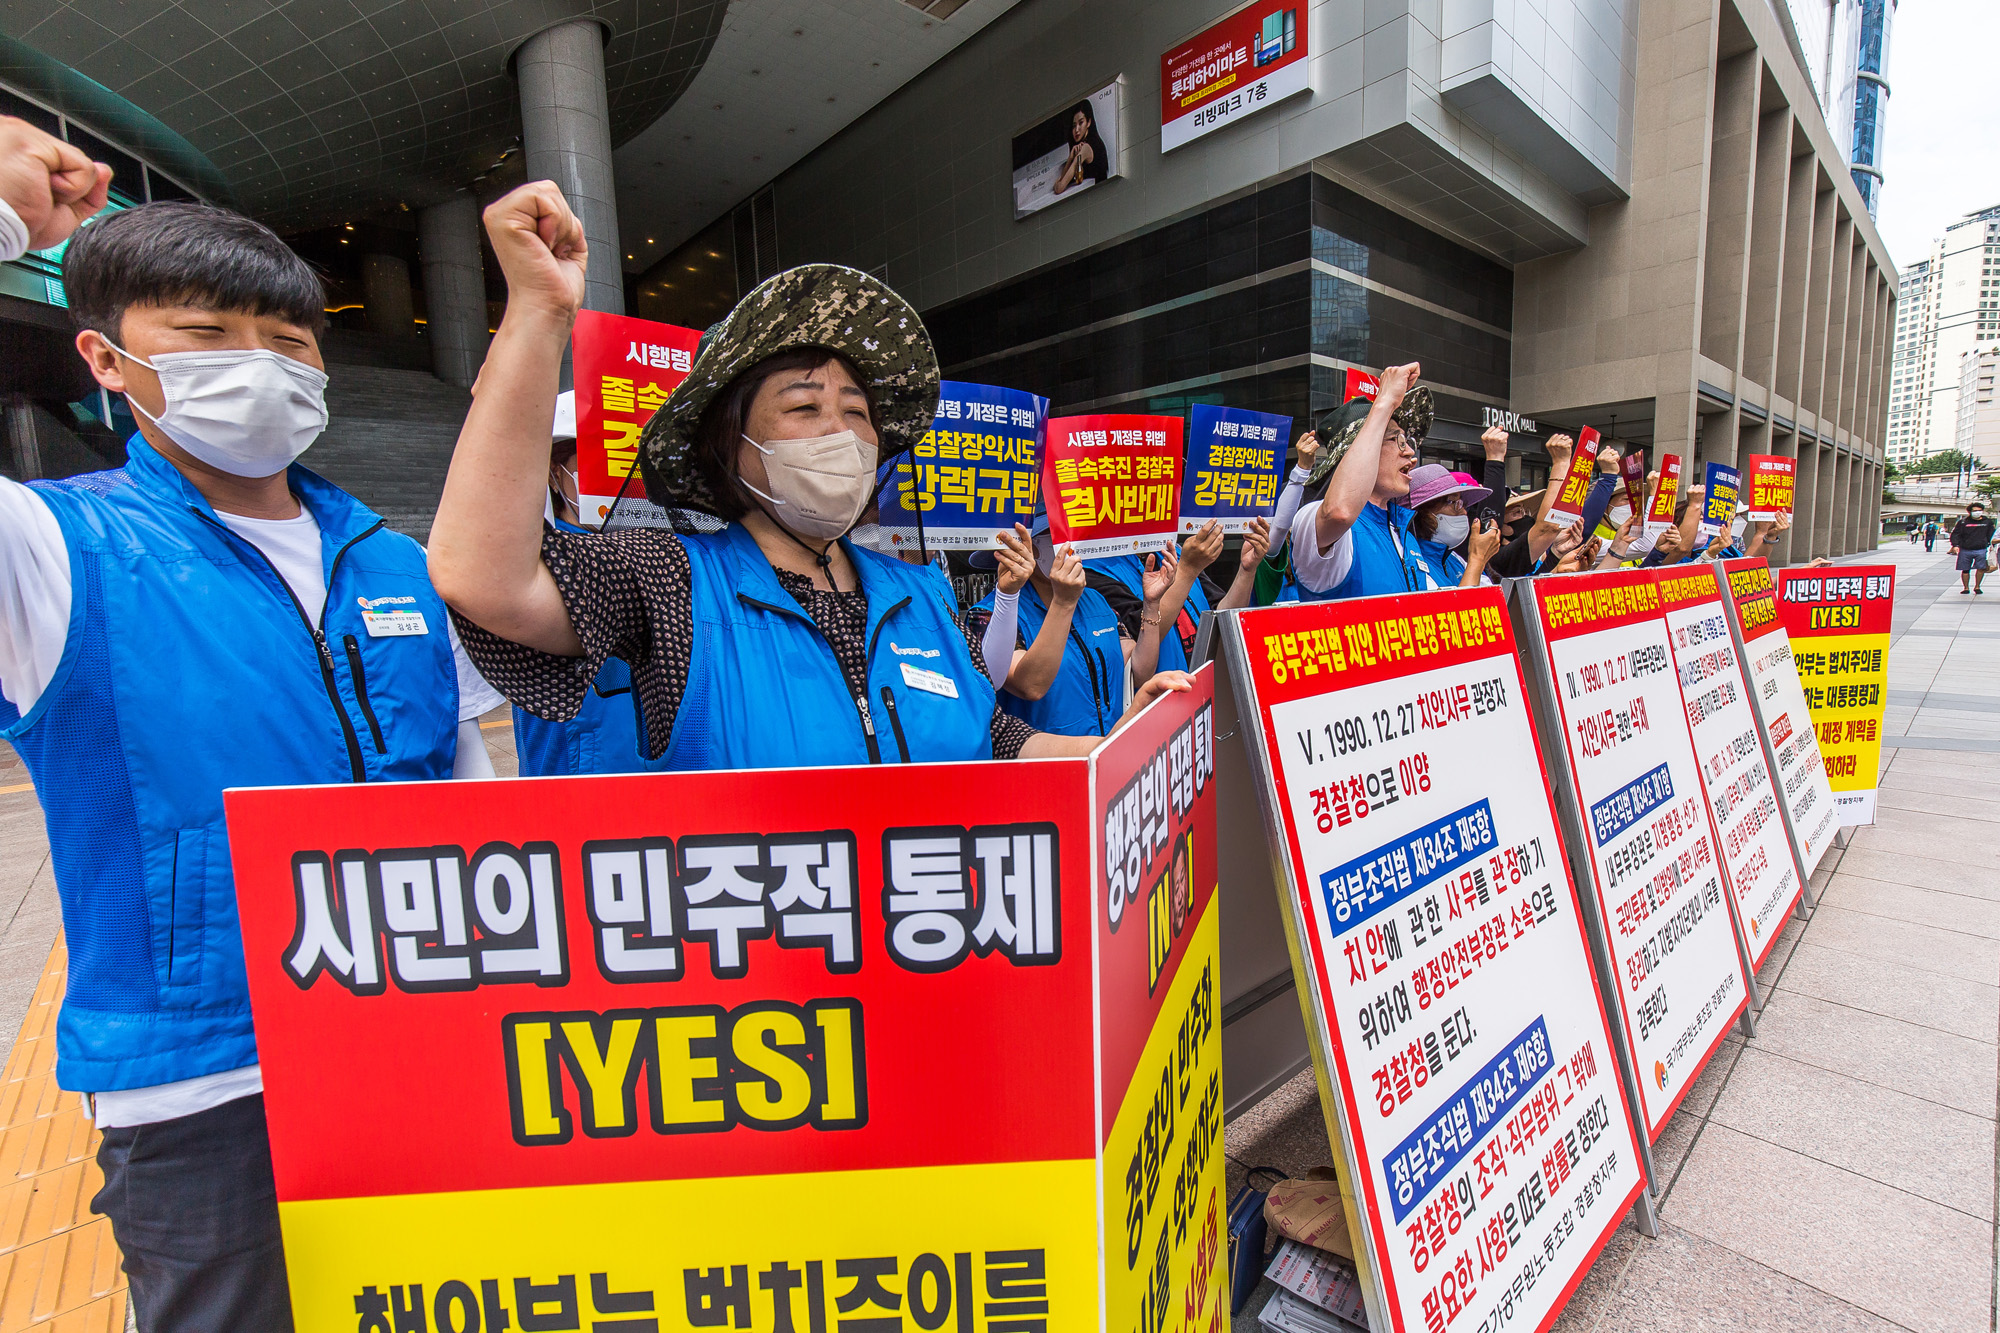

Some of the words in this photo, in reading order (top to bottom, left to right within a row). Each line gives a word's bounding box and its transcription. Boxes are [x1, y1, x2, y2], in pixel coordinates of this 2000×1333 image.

[1170, 46, 1248, 100] 롯데하이마트
[1194, 94, 1242, 127] 리빙파크
[1247, 82, 1268, 103] 7층
[626, 341, 691, 373] 시행령
[601, 375, 677, 414] 졸속
[966, 402, 1008, 424] 개정은
[1011, 408, 1035, 429] 위법!
[914, 429, 1036, 466] 경찰장악시도
[1067, 430, 1107, 448] 시행령
[1110, 431, 1143, 446] 개정은
[1145, 431, 1166, 447] 위법!
[1212, 421, 1239, 438] 시행령
[1240, 423, 1261, 440] 개정은
[1261, 427, 1278, 442] 위법!
[1520, 417, 1537, 433] MALL
[1054, 456, 1132, 484] 졸속추진
[1135, 456, 1175, 480] 경찰국
[1209, 445, 1275, 469] 경찰장악시도
[1060, 484, 1173, 528] 결사반대!
[1194, 471, 1278, 508] 강력규탄!
[905, 536, 961, 544] 국가무원노동조합
[1544, 591, 1583, 629] 정부조직법
[1579, 591, 1597, 621] 치안
[1594, 588, 1615, 619] 사무의
[1613, 586, 1626, 616] 관장
[1624, 584, 1638, 614] 주체
[1636, 583, 1649, 612] 변경
[1647, 582, 1660, 609] 연혁
[1784, 578, 1822, 602] 시민의
[1825, 576, 1863, 601] 민주적
[1866, 575, 1891, 599] 통제
[1263, 627, 1347, 684] 정부조직법
[1343, 623, 1376, 668] 치안
[1375, 617, 1416, 662] 사무의
[1414, 615, 1439, 656] 관장
[1438, 611, 1463, 651] 주체
[1460, 608, 1483, 647] 변경
[1481, 605, 1505, 642] 연혁
[1810, 605, 1860, 629] [YES]
[1580, 663, 1604, 694] 1990.
[1604, 659, 1617, 686] 12.
[1617, 655, 1628, 681] 27
[1628, 644, 1668, 678] 내무부장관의
[1795, 653, 1825, 676] 안부는
[1829, 649, 1882, 674] 법치주의를
[1297, 729, 1324, 767] V.
[1324, 716, 1372, 758] 1990.
[1372, 709, 1398, 744] 12.
[1398, 702, 1415, 737] 27
[1416, 684, 1471, 731] 치안사무
[1471, 677, 1508, 716] 관장자
[1804, 687, 1823, 710] 하는
[1827, 684, 1880, 709] 대통령령과
[1577, 709, 1617, 759] 치안사무
[1616, 710, 1632, 742] 권한
[1629, 696, 1649, 735] 삭제
[1821, 722, 1842, 745] 제정
[1845, 719, 1877, 744] 계획을
[1309, 766, 1400, 835] 경찰청으로
[1399, 751, 1432, 796] 이양
[1823, 755, 1857, 778] 회하라
[1105, 742, 1169, 932] 행정부의
[1169, 718, 1194, 822] 직접
[1194, 699, 1213, 797] 통제
[1594, 790, 1634, 840] 정부조직법
[1629, 775, 1655, 815] 제34조
[1651, 766, 1672, 802] 제1항
[1328, 846, 1412, 923] 정부조직법
[1410, 822, 1459, 878] 제34조
[1455, 806, 1493, 852] 제5항
[1605, 829, 1655, 888] 내무부장관은
[1616, 887, 1650, 938] 국민투표
[1646, 881, 1657, 914] 및
[1653, 860, 1682, 907] 민방위에
[1678, 849, 1694, 885] 관한
[1691, 835, 1711, 871] 사무를
[284, 841, 569, 994] 시민의
[582, 829, 862, 984] 민주적
[882, 823, 1060, 973] 통제
[1343, 918, 1403, 987] 치안에
[1407, 894, 1443, 948] 관한
[1445, 867, 1490, 922] 사무를
[1489, 836, 1546, 895] 관장하기
[1626, 936, 1660, 992] 장리하고
[1658, 892, 1704, 957] 지방자치단체의
[1700, 876, 1720, 913] 사무를
[1358, 980, 1413, 1052] 위하여
[1411, 913, 1510, 1011] 행정안전부장관
[1510, 882, 1558, 940] 소속으로
[1637, 983, 1669, 1042] 감독한다
[1665, 1006, 1713, 1069] 국가공무원노동조합
[1711, 972, 1735, 1010] 경찰청지부
[501, 998, 867, 1146] [YES]
[1372, 1031, 1443, 1118] 경찰청을
[1441, 1006, 1478, 1062] 둔다.
[1126, 1049, 1174, 1271] 경찰의
[1178, 955, 1212, 1113] 민주화
[1390, 1108, 1473, 1206] 정부조직법
[1469, 1057, 1518, 1128] 제34조
[1513, 1027, 1549, 1088] 제6항
[1174, 1067, 1219, 1252] 역행하는
[1406, 1170, 1476, 1274] 경찰청의
[1558, 1065, 1575, 1108] 그
[1571, 1040, 1598, 1090] 밖에
[1574, 1150, 1619, 1219] 경찰청지부
[1315, 1213, 1340, 1234] HANKUK
[1421, 1248, 1478, 1333] 필요한
[1476, 1202, 1522, 1282] 사항은
[1517, 1170, 1547, 1228] 따로
[1541, 1129, 1581, 1198] 법률로
[1576, 1094, 1610, 1154] 정한다
